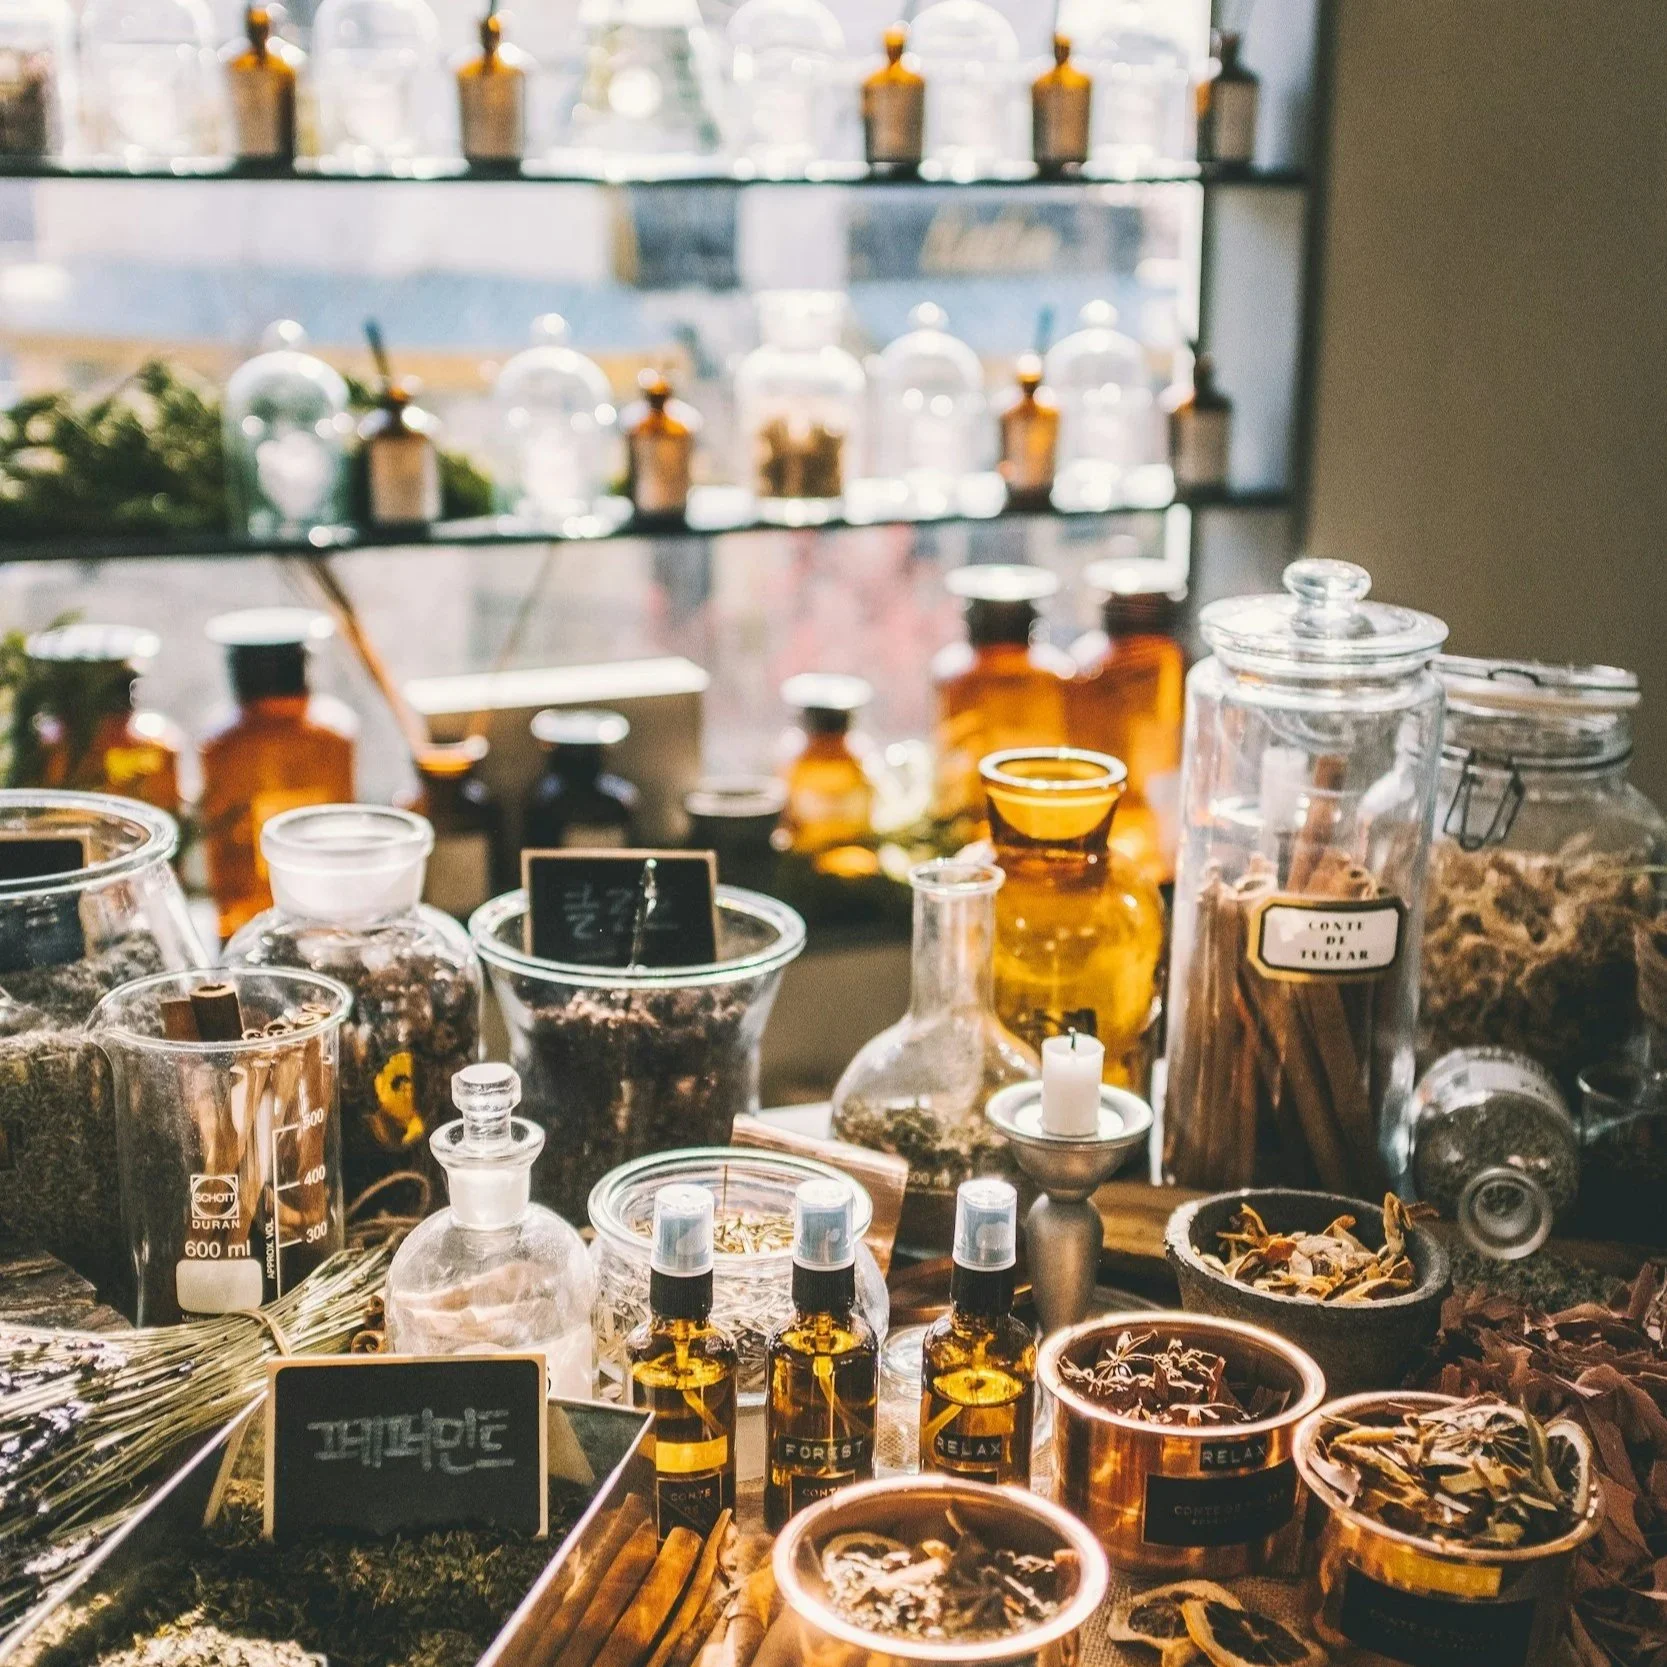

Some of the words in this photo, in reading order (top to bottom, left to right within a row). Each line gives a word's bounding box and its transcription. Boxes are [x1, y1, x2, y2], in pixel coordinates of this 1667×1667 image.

[303, 1165, 326, 1186] 400
[194, 1192, 235, 1203] SCHOTT
[192, 1219, 240, 1230] DURAN
[306, 1221, 328, 1243] 300
[184, 1240, 221, 1258] 600
[227, 1239, 251, 1258] ml
[307, 1407, 516, 1475] 페퍼민트
[785, 1440, 863, 1460] FOREST
[936, 1435, 1001, 1456] RELAX
[1202, 1444, 1266, 1465] RELAX
[802, 1487, 840, 1497] CONT
